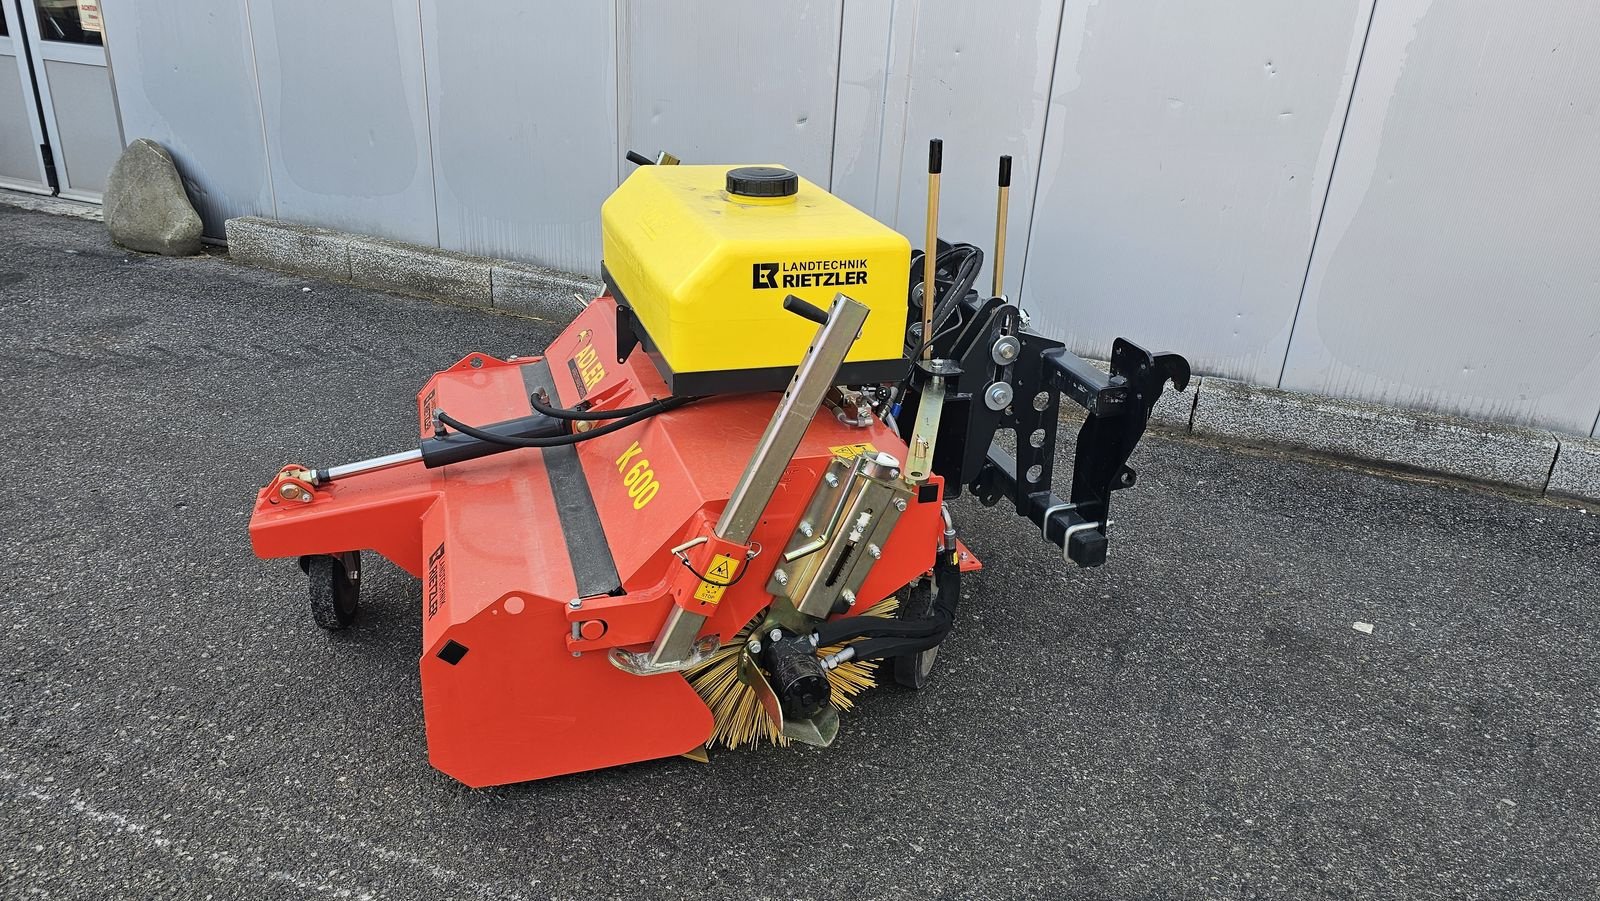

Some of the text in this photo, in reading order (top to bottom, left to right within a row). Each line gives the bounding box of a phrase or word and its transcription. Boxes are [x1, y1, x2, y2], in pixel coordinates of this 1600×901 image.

[782, 271, 868, 288] RIETZLER
[783, 259, 867, 272] LANDTECHNIK
[575, 343, 606, 393] ADLER
[615, 440, 660, 510] K 600
[428, 564, 438, 621] RIETZLER
